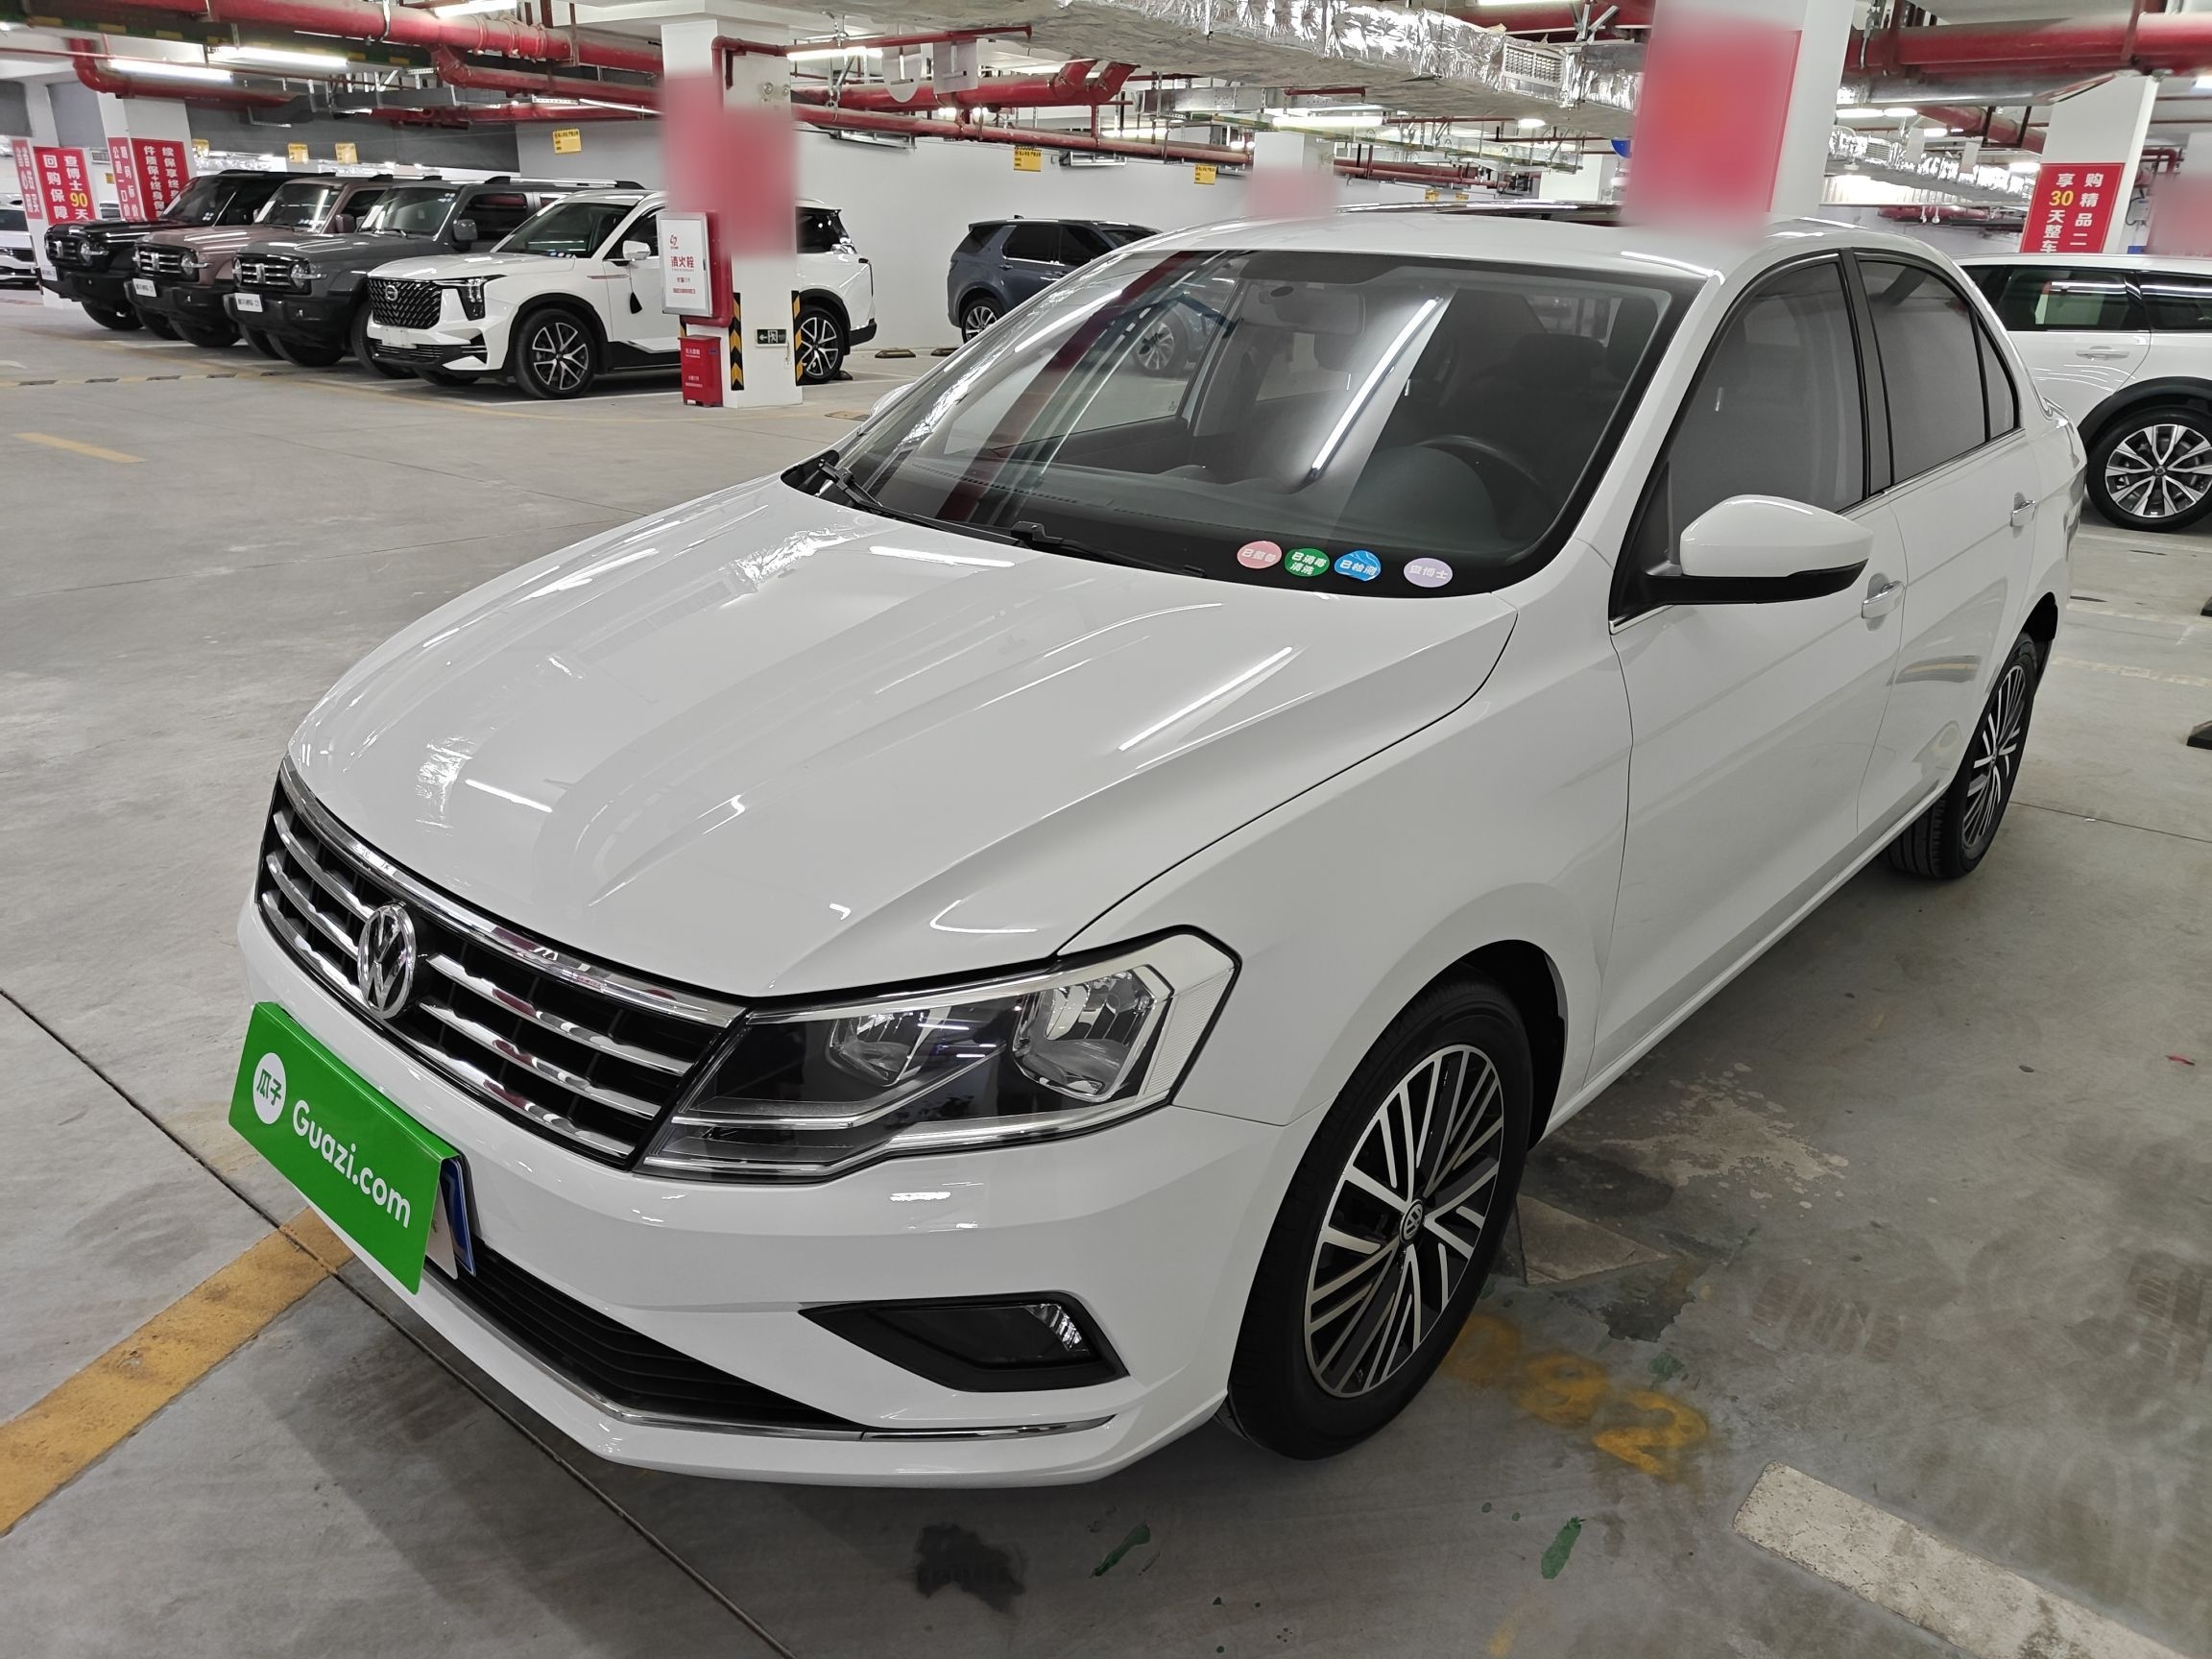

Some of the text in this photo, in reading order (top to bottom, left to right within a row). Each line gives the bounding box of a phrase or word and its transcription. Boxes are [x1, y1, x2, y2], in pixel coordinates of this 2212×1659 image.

[42, 154, 69, 219] 回购保障
[1291, 551, 1328, 568] 已消毒
[1339, 559, 1378, 576] 已检测
[1289, 562, 1315, 575] 清洗
[1409, 565, 1449, 580] 查博士
[256, 1068, 282, 1106] 瓜子
[292, 1099, 411, 1229] Guazi.com
